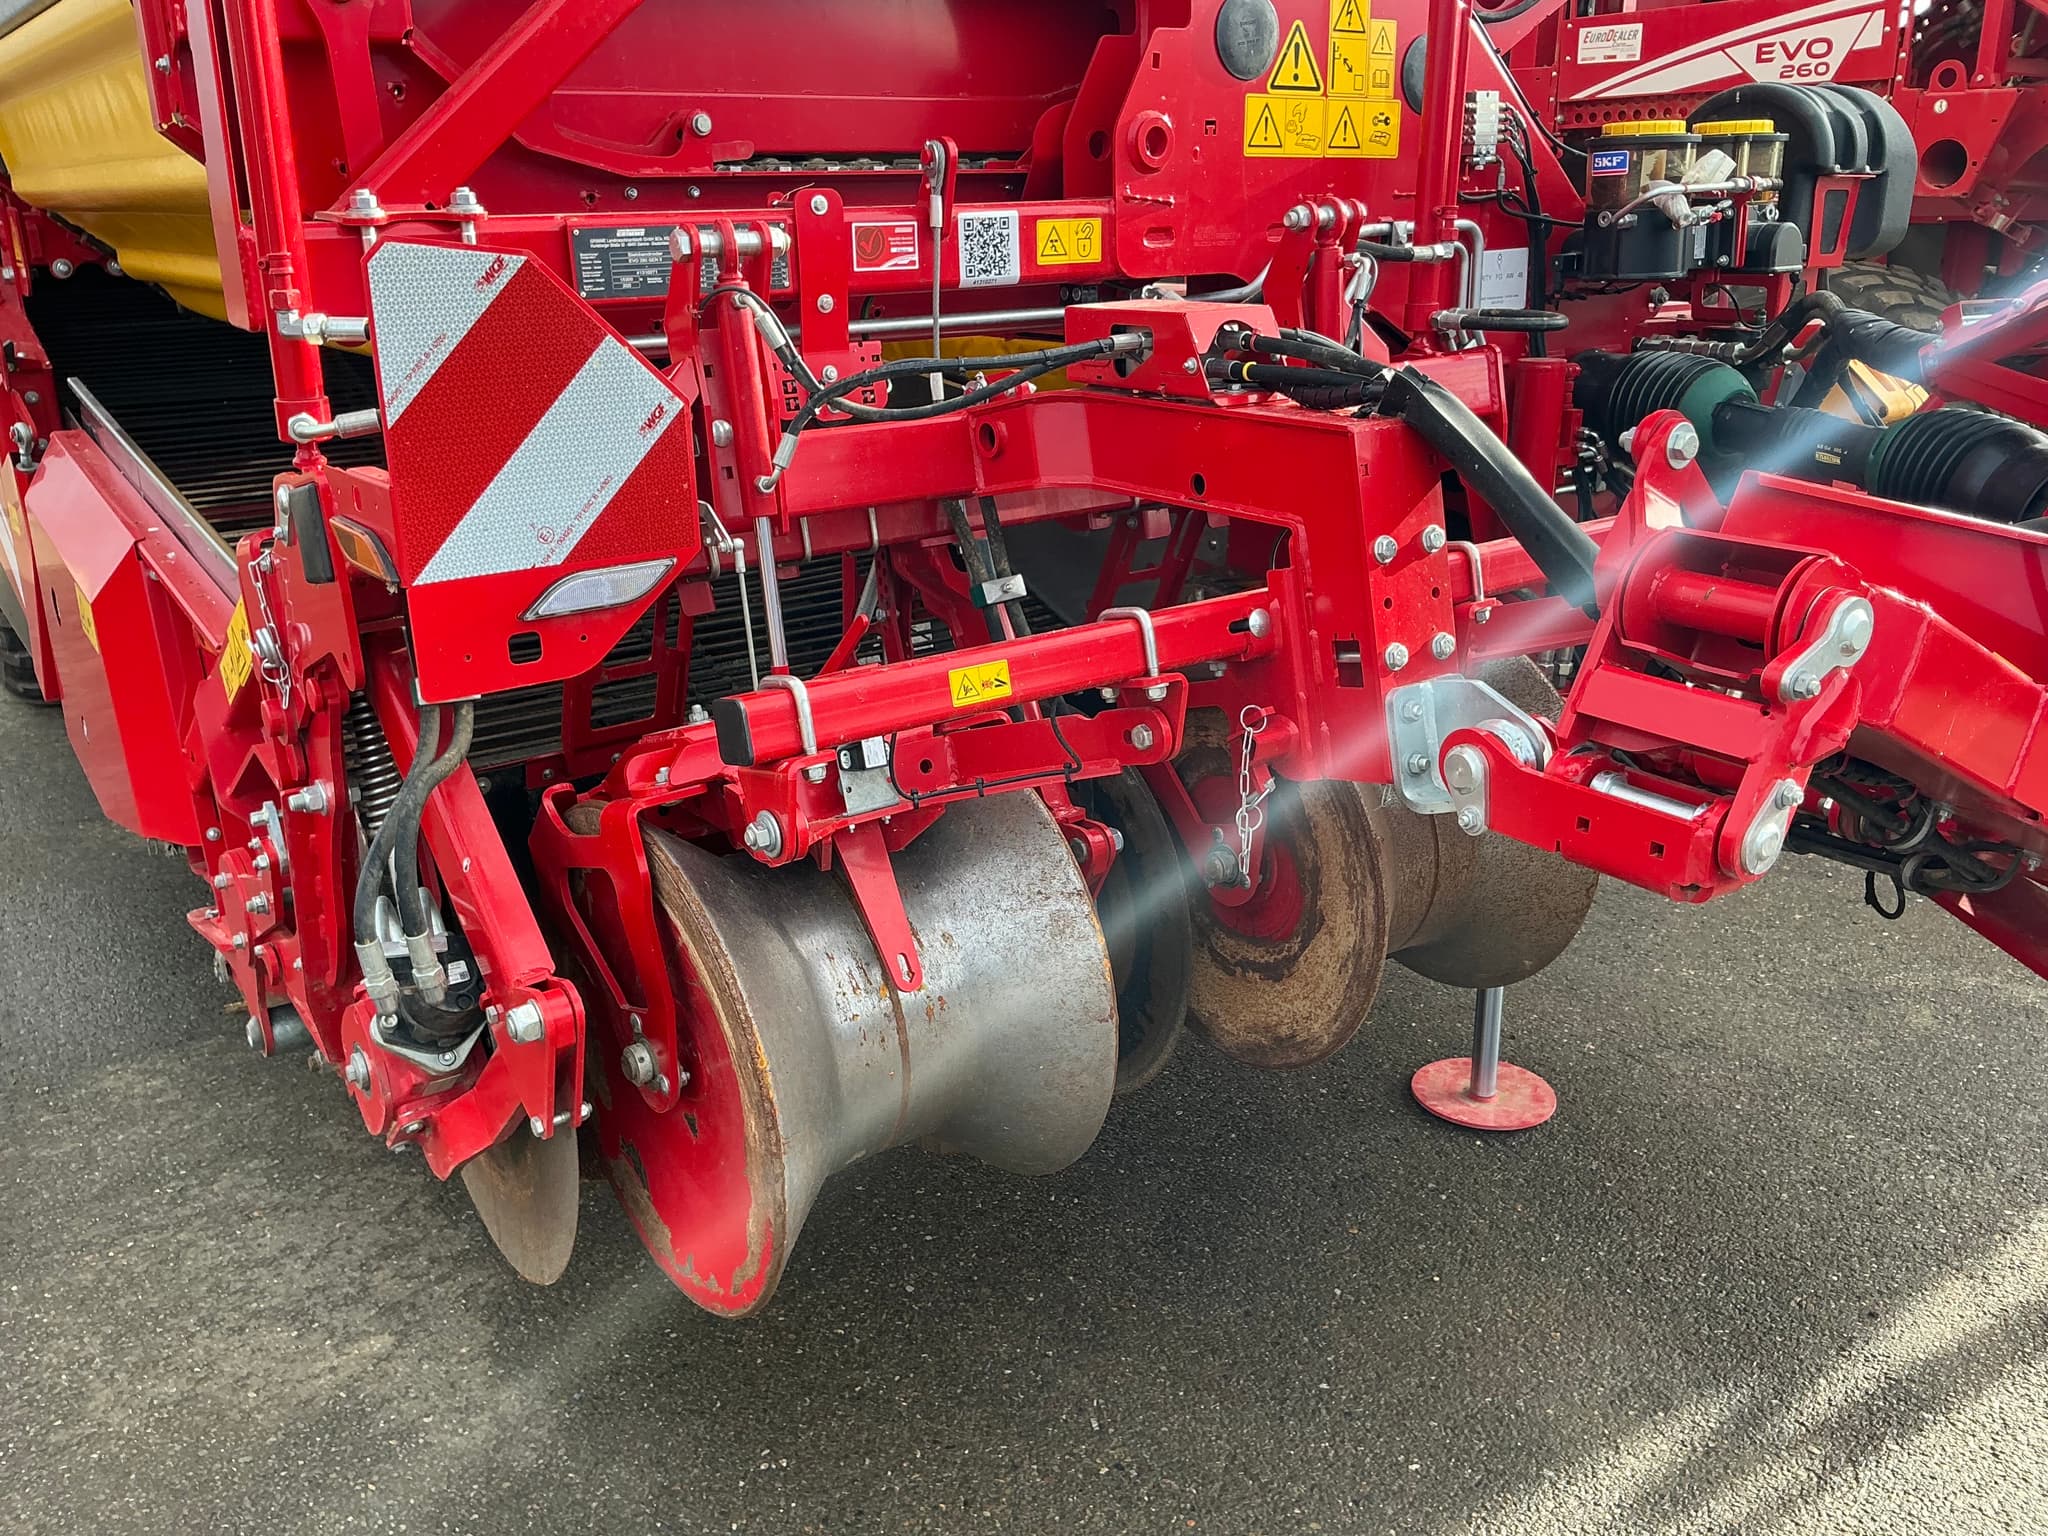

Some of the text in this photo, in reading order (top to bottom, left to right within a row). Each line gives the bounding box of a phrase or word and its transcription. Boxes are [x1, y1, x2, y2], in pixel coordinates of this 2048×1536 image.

[1756, 37, 1834, 64] EVO
[1779, 61, 1831, 79] 260
[1594, 155, 1625, 168] SKF
